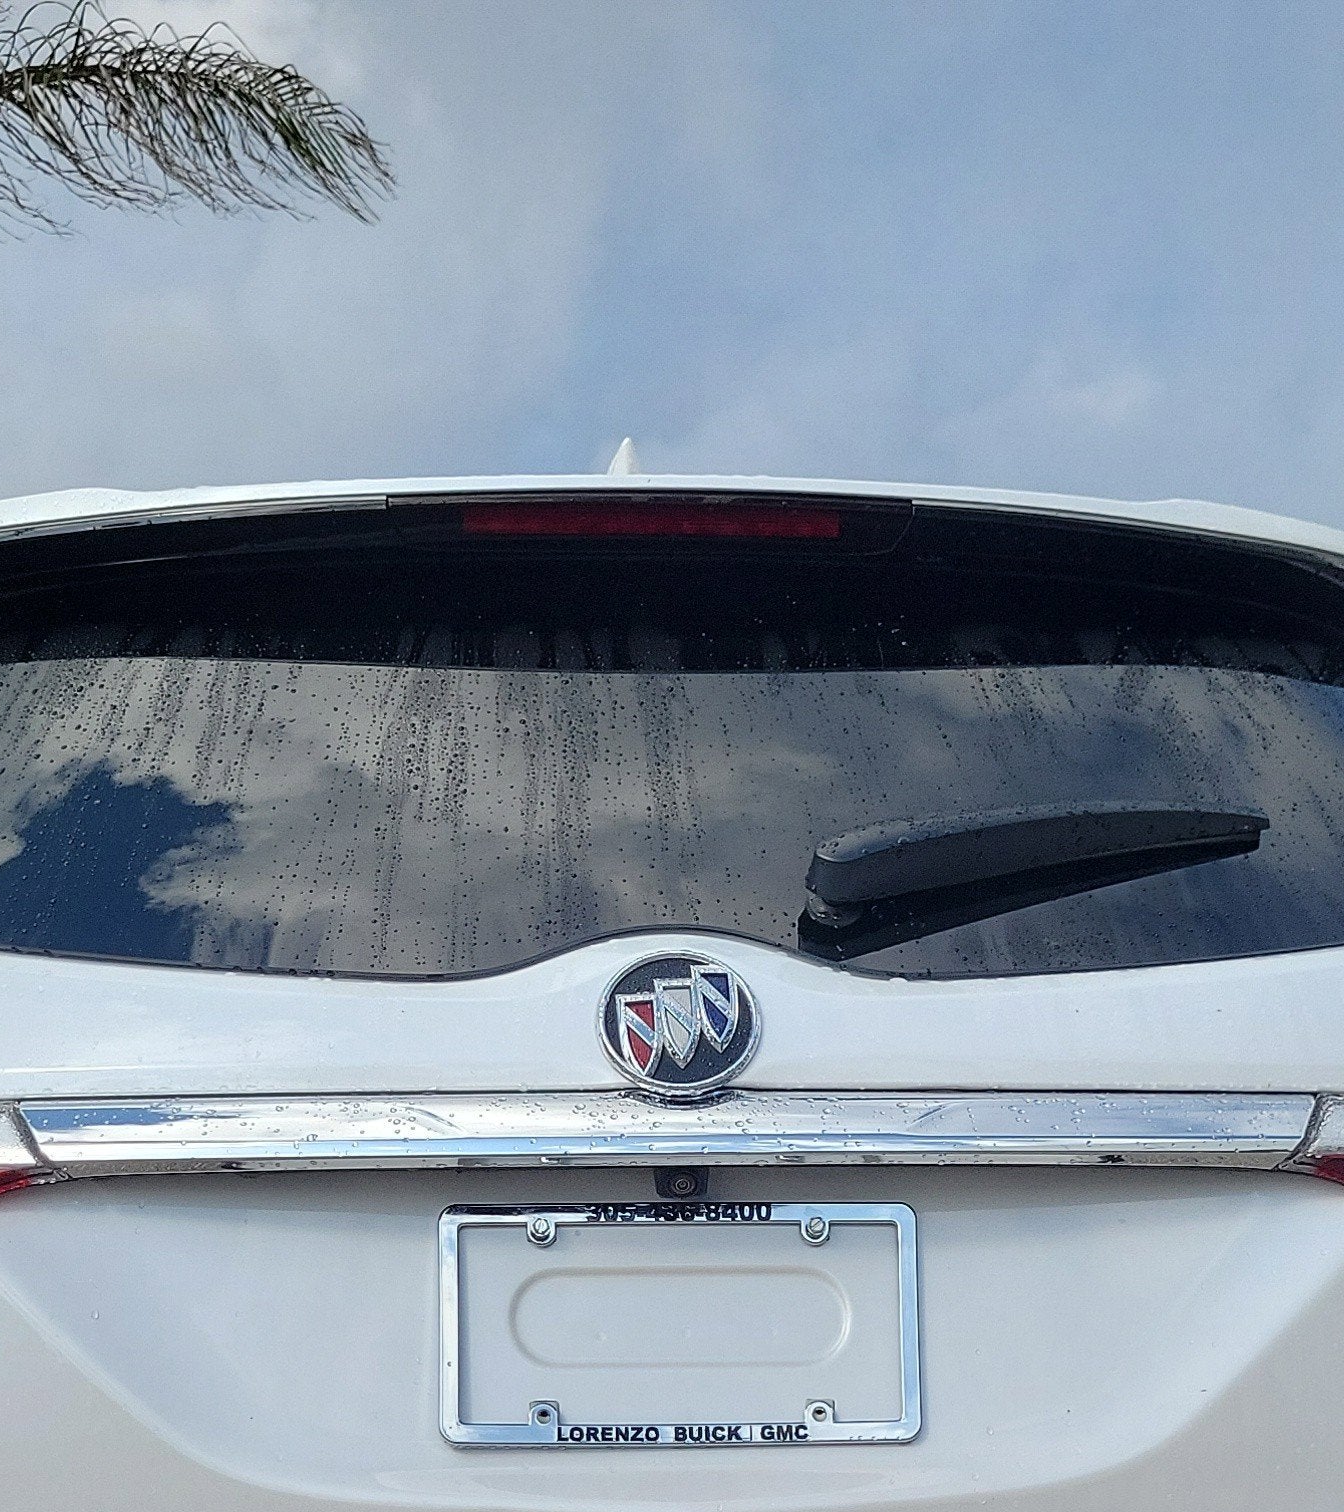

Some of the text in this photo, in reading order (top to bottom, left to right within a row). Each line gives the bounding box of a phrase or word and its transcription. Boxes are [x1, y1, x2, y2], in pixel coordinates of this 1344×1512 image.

[556, 1424, 809, 1443] LORENZO BUICK GMC
